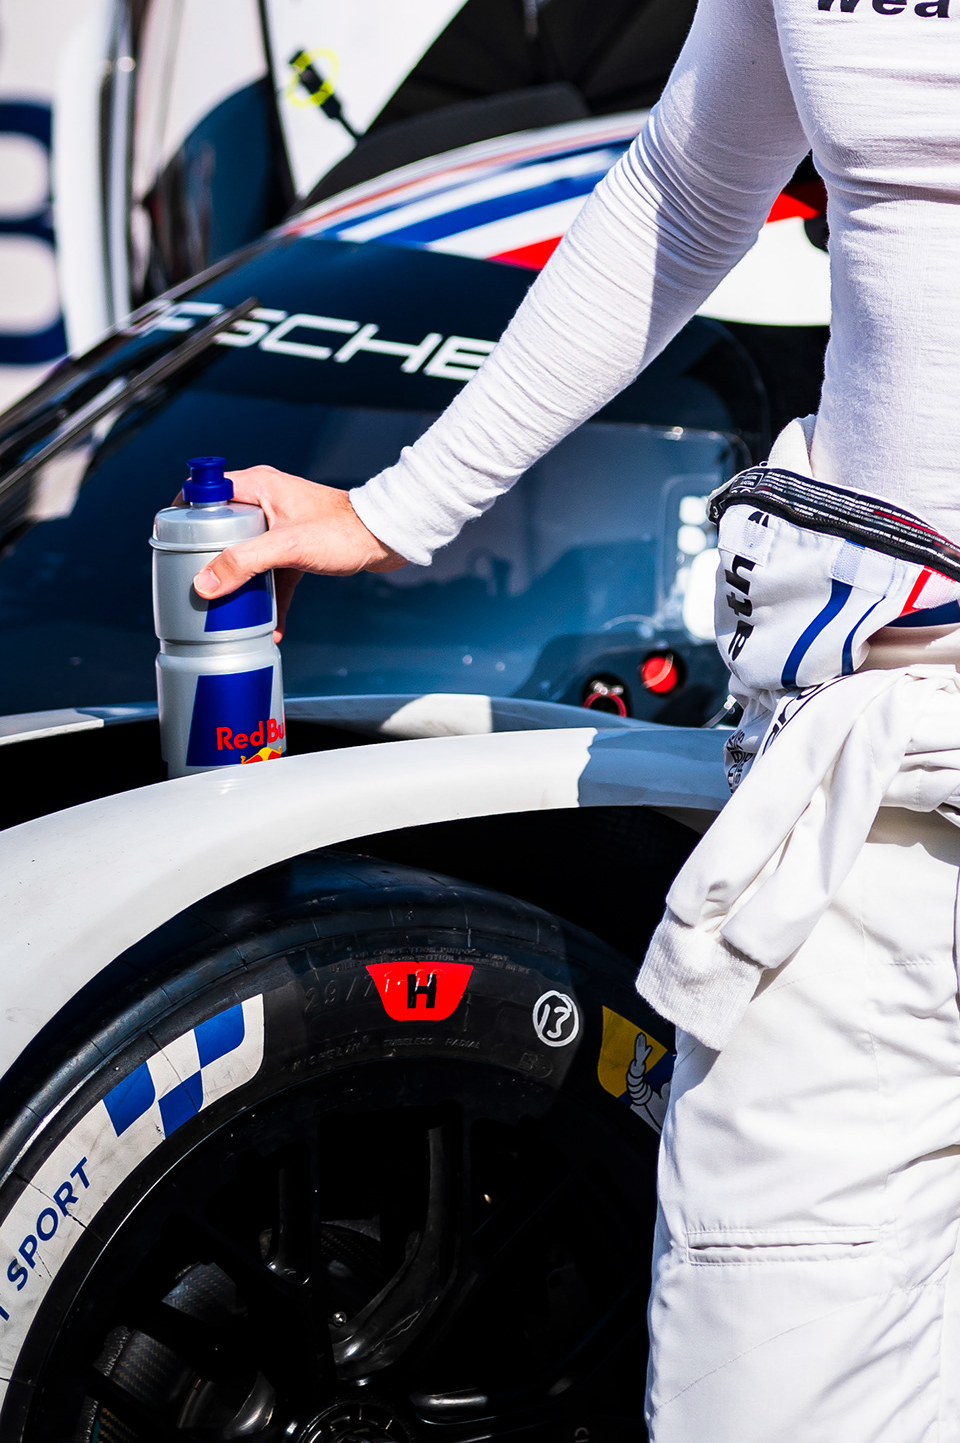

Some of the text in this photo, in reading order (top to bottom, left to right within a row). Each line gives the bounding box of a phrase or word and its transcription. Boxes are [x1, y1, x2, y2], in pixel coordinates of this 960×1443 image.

[216, 713, 286, 751] Red Bu
[406, 973, 437, 1009] H
[538, 1003, 573, 1039] 13
[6, 1156, 91, 1291] SPORT
